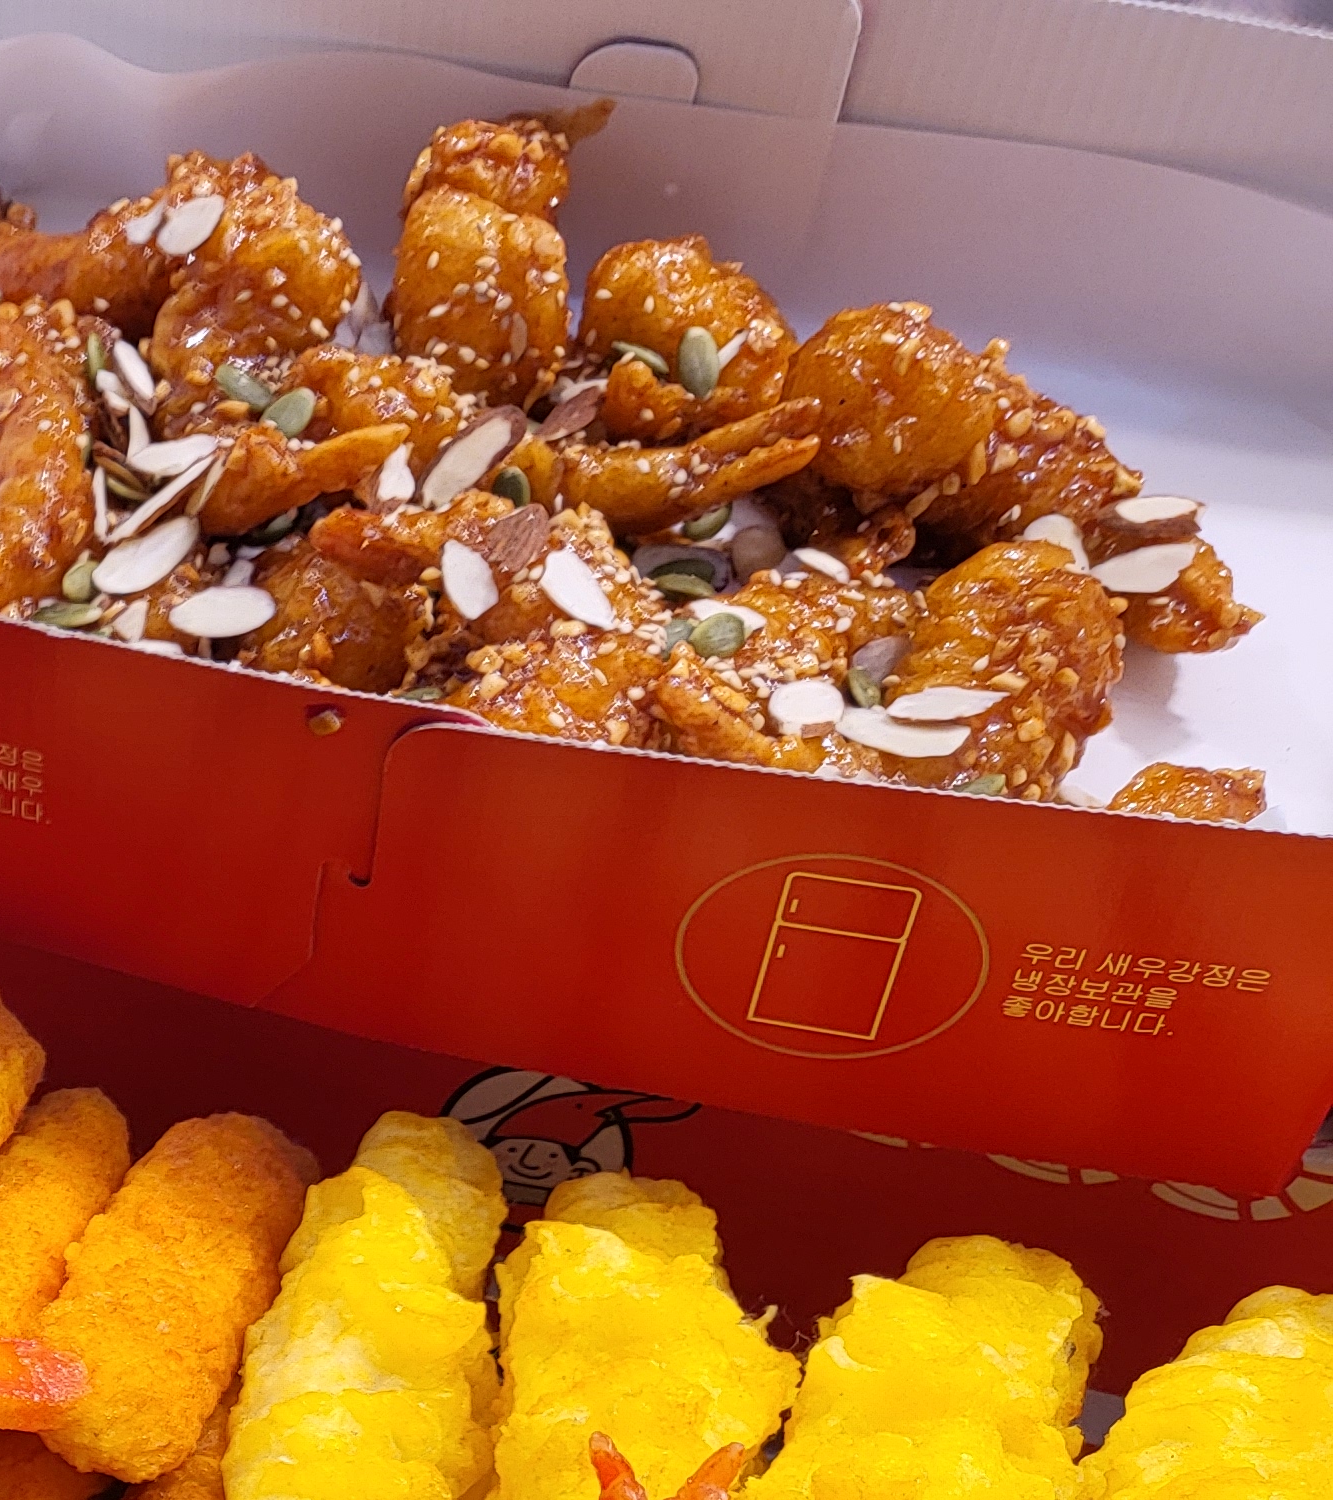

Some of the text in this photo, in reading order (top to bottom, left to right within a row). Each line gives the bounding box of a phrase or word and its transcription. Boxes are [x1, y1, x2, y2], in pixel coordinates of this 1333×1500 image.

[1011, 968, 1178, 1010] 냉장보관을
[1020, 943, 1272, 993] 우리 새우강정은
[1001, 994, 1174, 1037] 좋아합니다.
